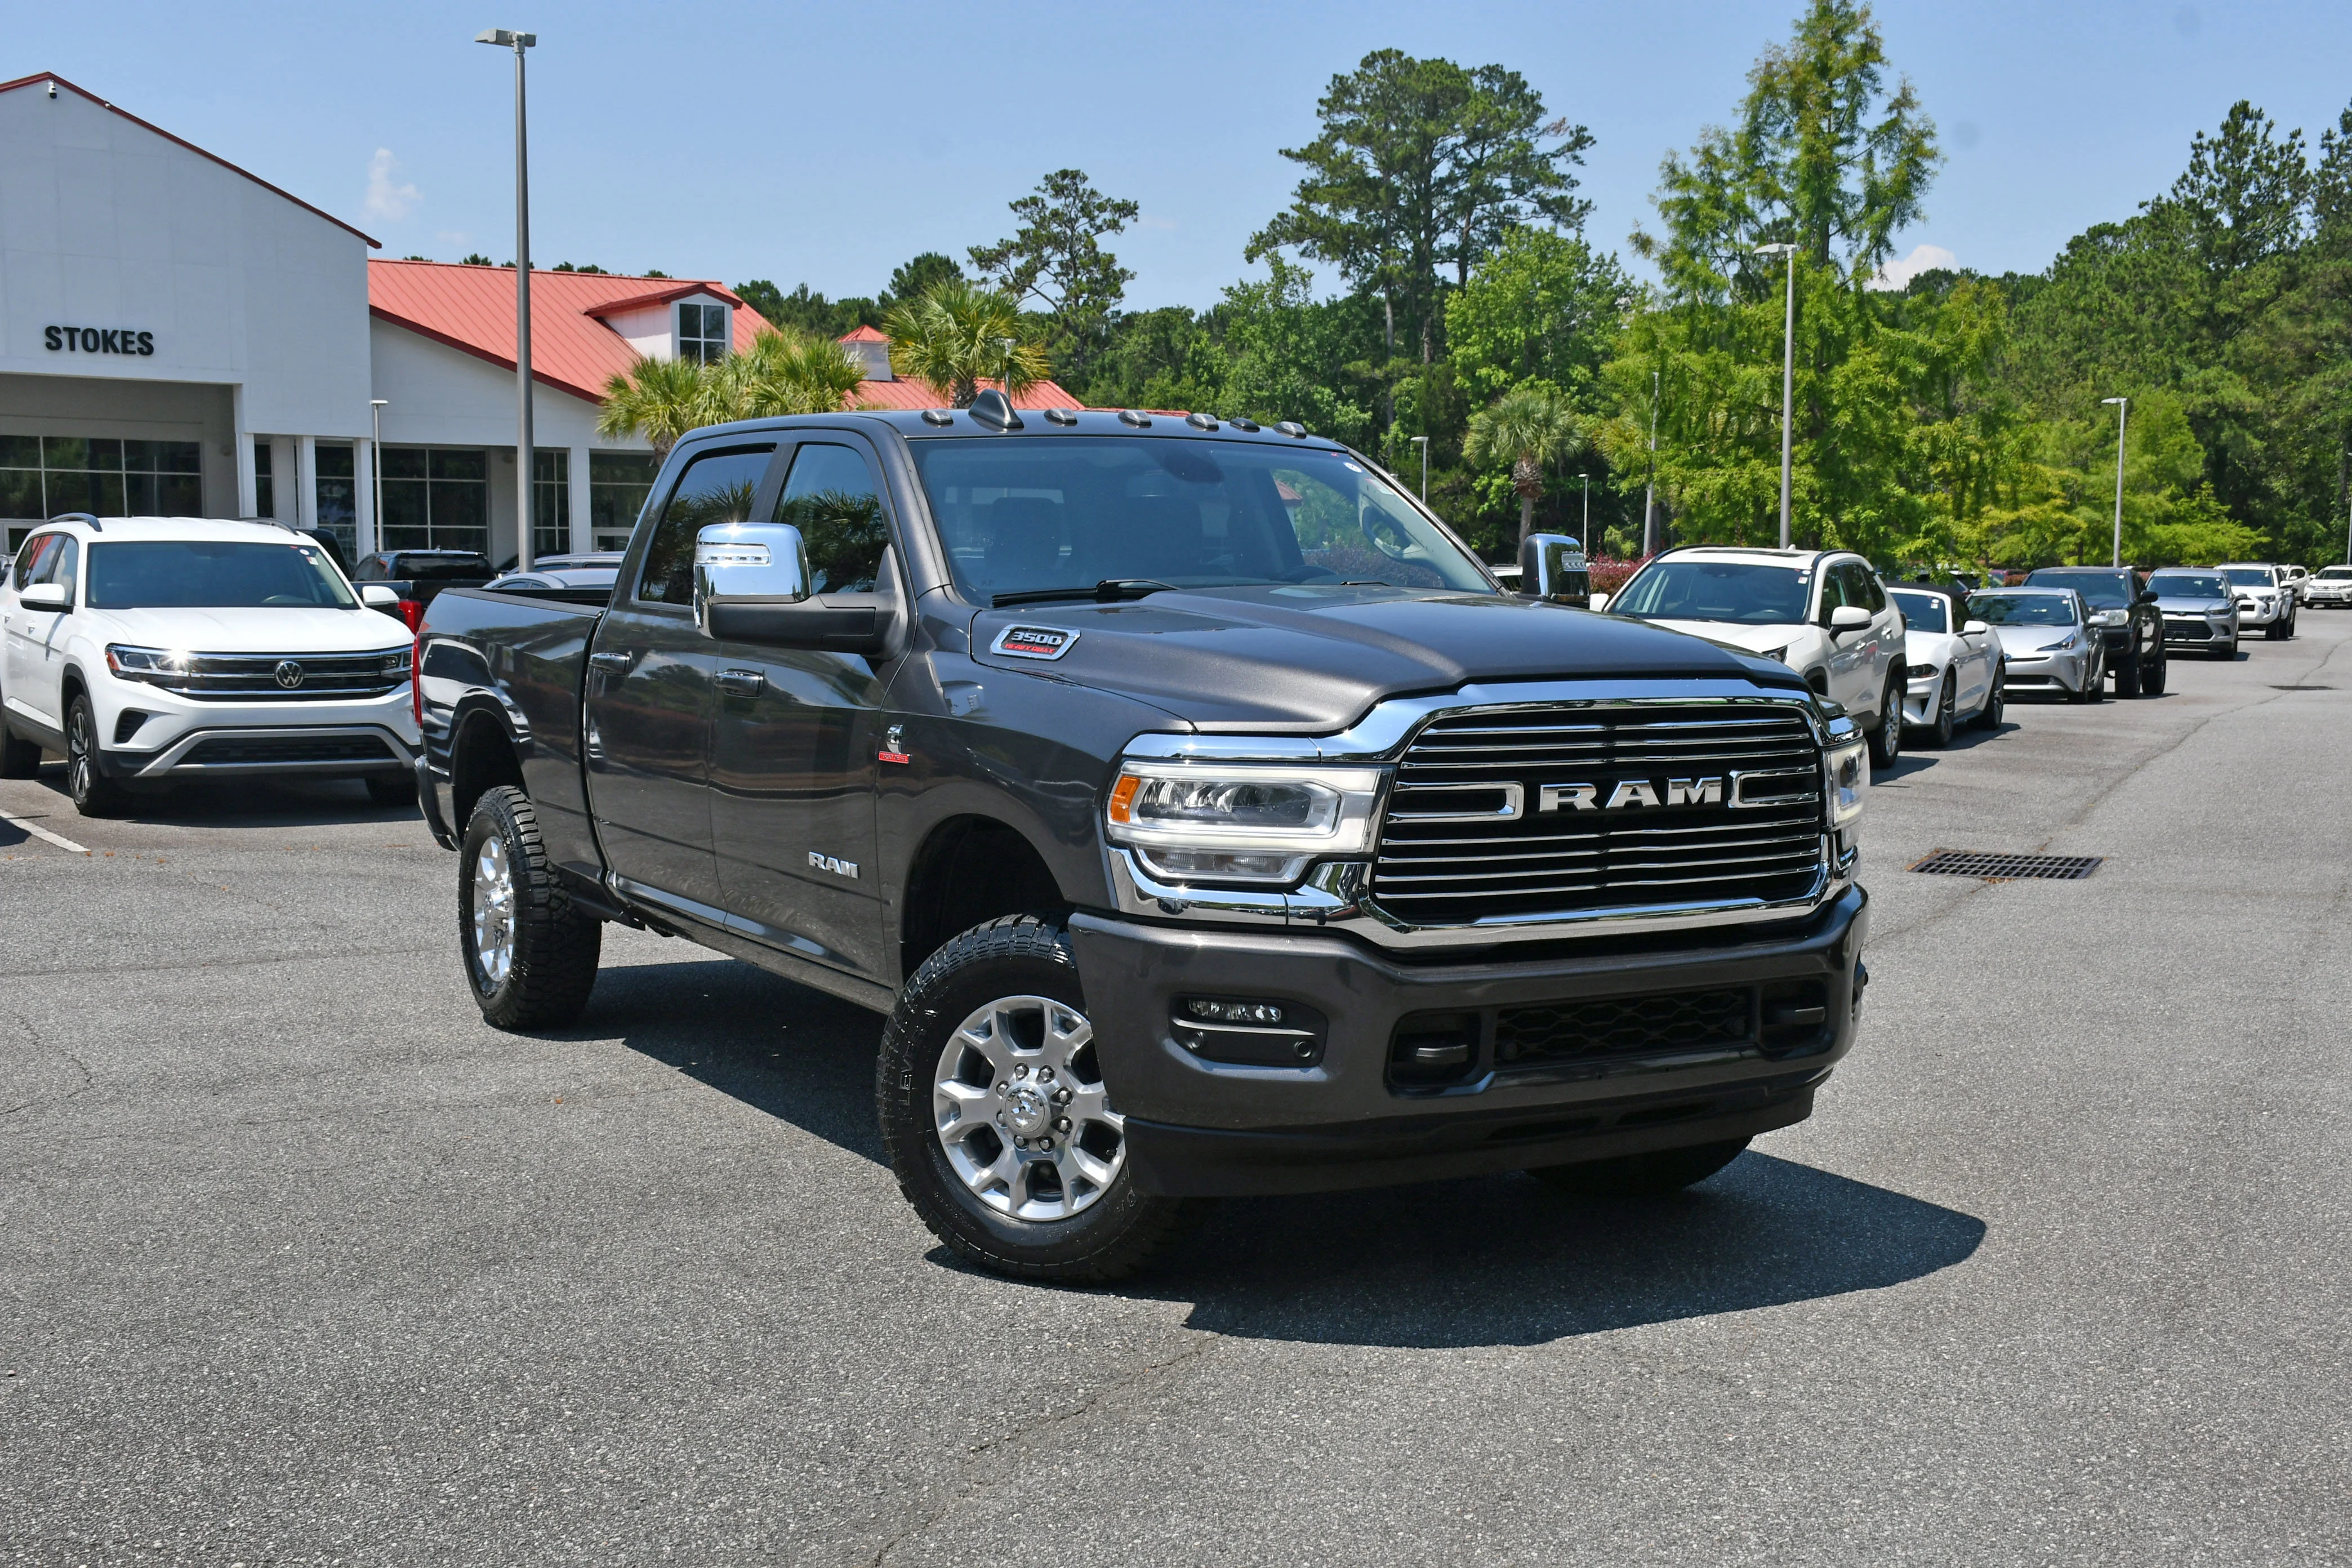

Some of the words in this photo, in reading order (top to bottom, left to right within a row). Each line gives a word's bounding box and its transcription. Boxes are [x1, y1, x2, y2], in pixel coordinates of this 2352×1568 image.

[44, 326, 154, 356] STOKES
[1011, 631, 1062, 645] 3500
[1539, 777, 1722, 812] RAM
[808, 852, 858, 879] RAM
